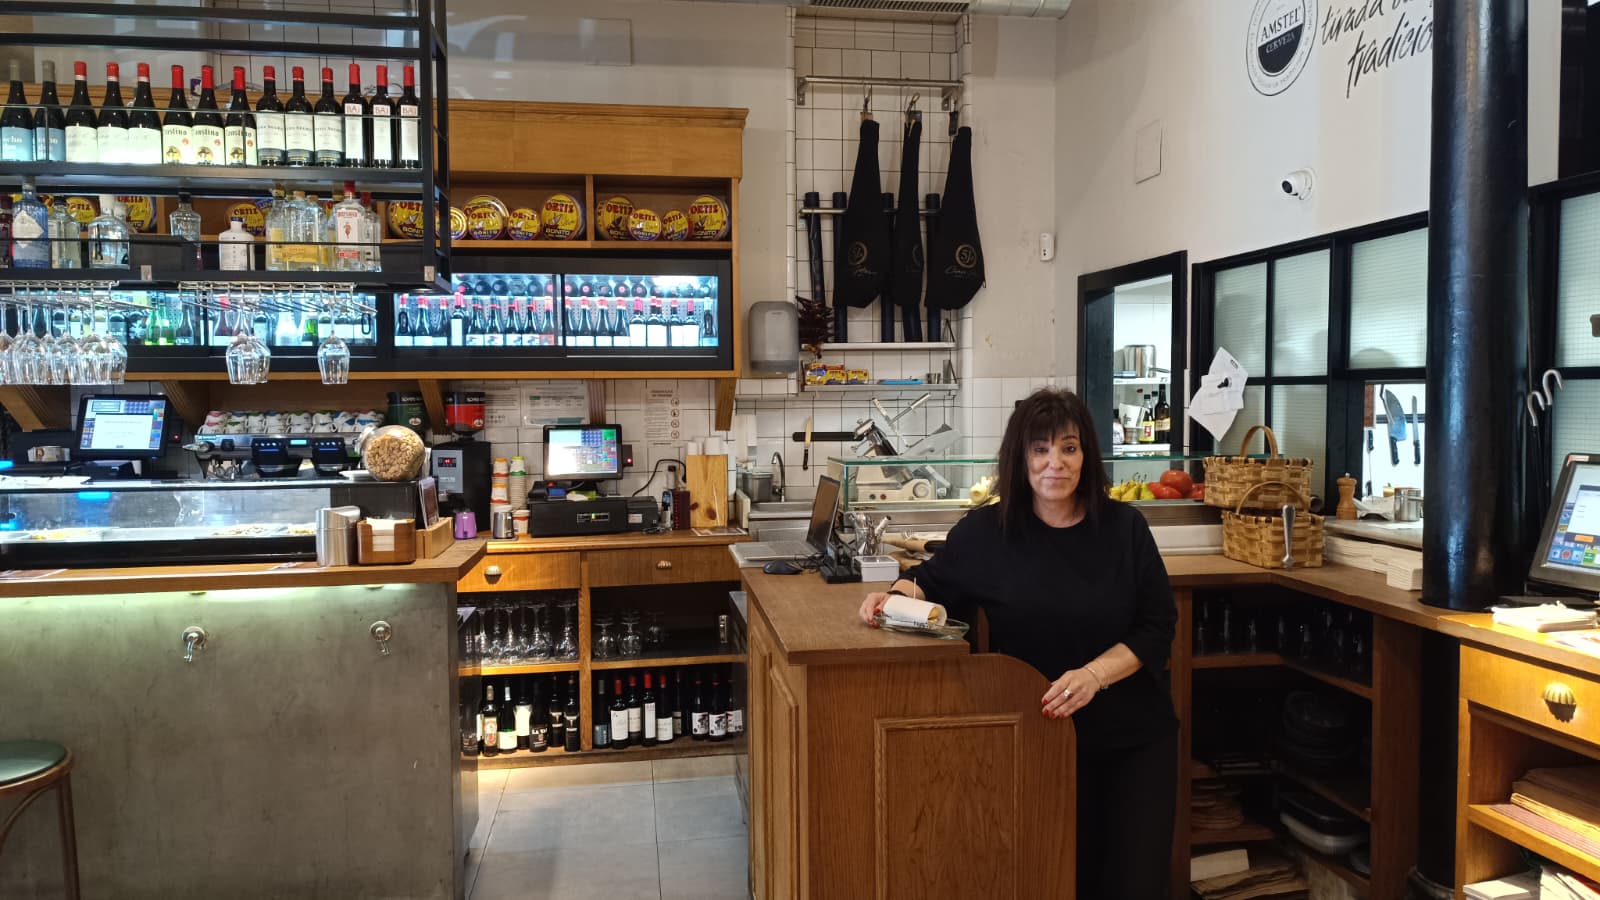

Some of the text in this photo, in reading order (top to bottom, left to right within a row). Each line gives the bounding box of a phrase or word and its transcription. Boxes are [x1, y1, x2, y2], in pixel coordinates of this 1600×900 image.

[1260, 6, 1301, 42] AMSTEL
[1321, 0, 1384, 46] tirada
[1265, 31, 1296, 54] CERVEZA
[1346, 12, 1433, 99] tradicio
[512, 212, 536, 221] ORZ
